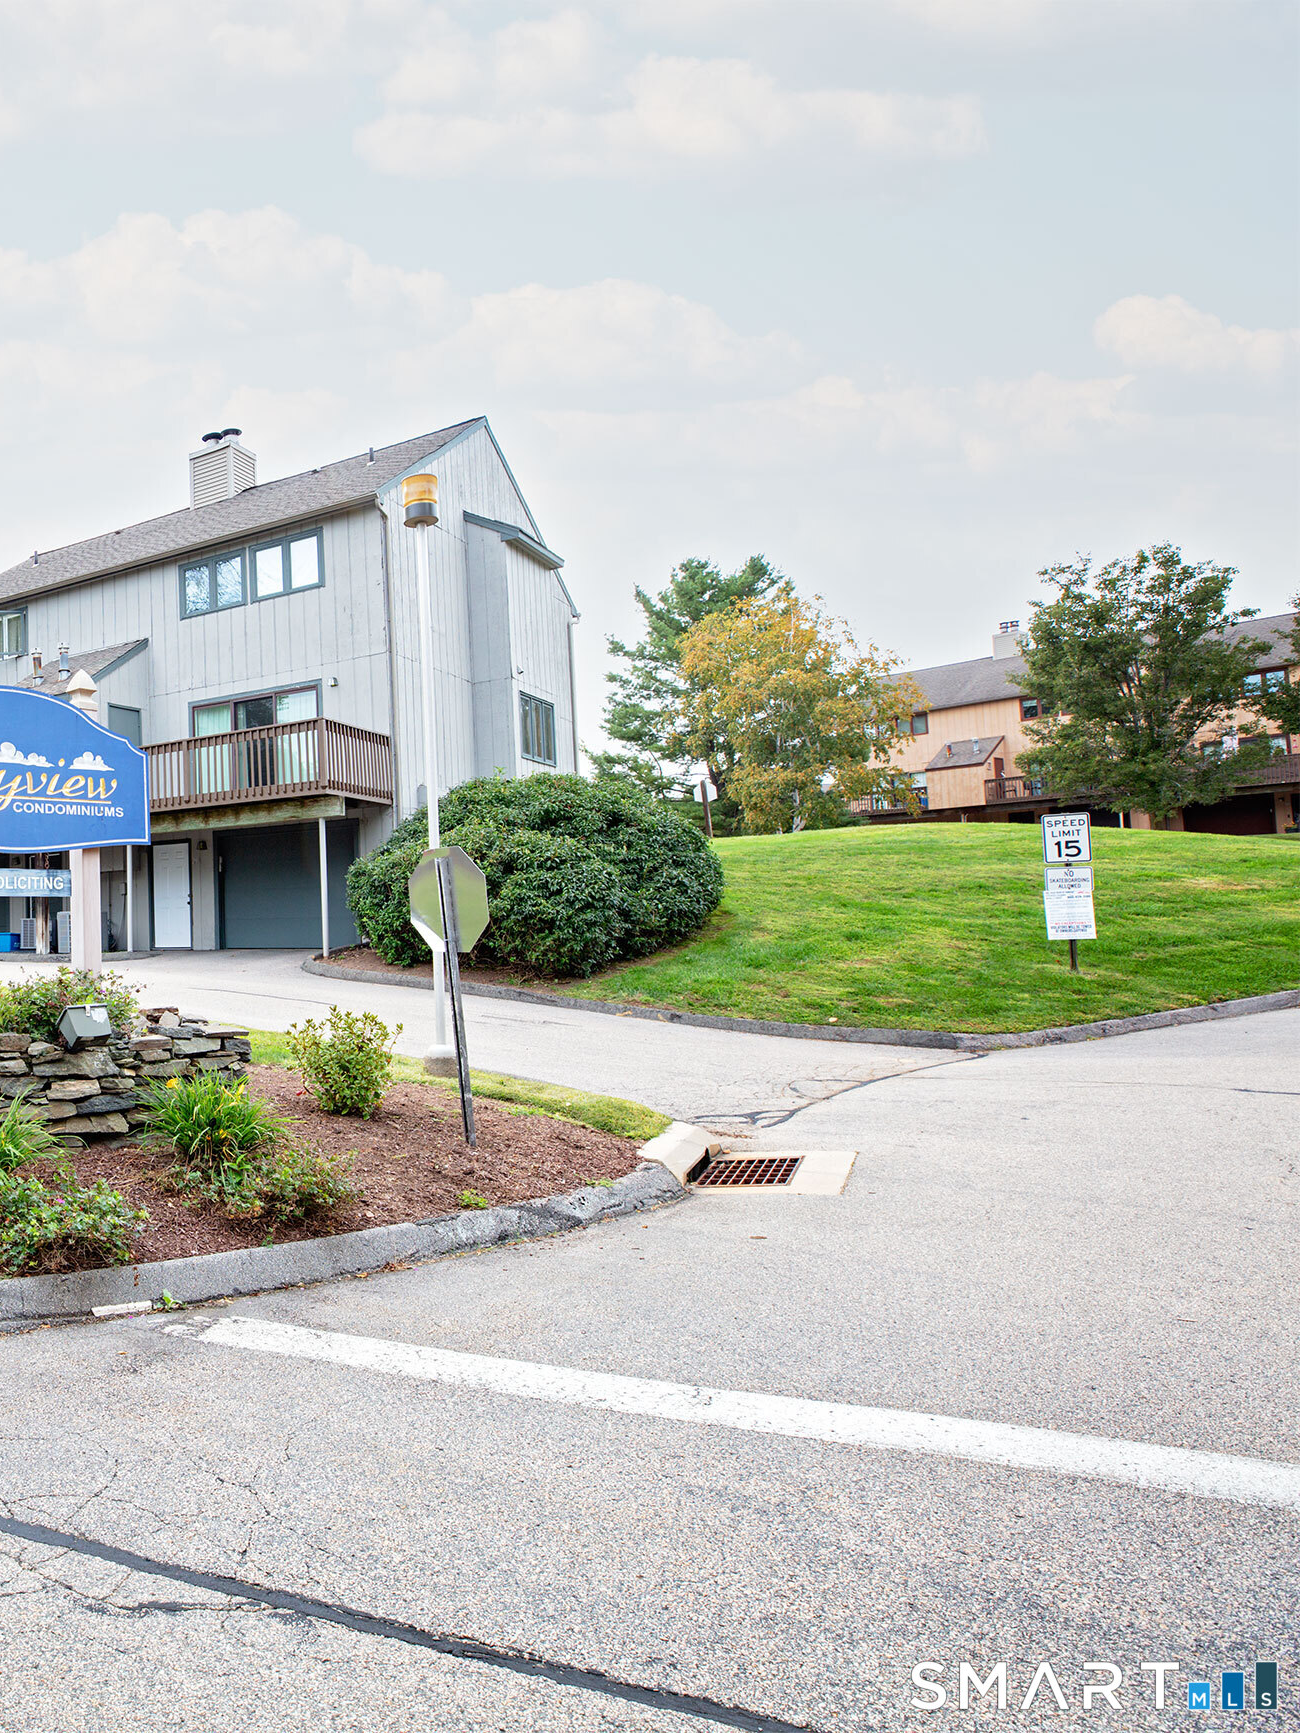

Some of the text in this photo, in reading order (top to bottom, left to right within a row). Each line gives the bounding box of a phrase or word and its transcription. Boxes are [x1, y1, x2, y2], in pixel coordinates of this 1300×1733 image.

[12, 802, 124, 818] CONDOMINIUMS
[1046, 818, 1086, 828] SPEED
[1051, 829, 1081, 838] LIMIT
[1054, 840, 1082, 858] 15
[1063, 870, 1075, 878] NO
